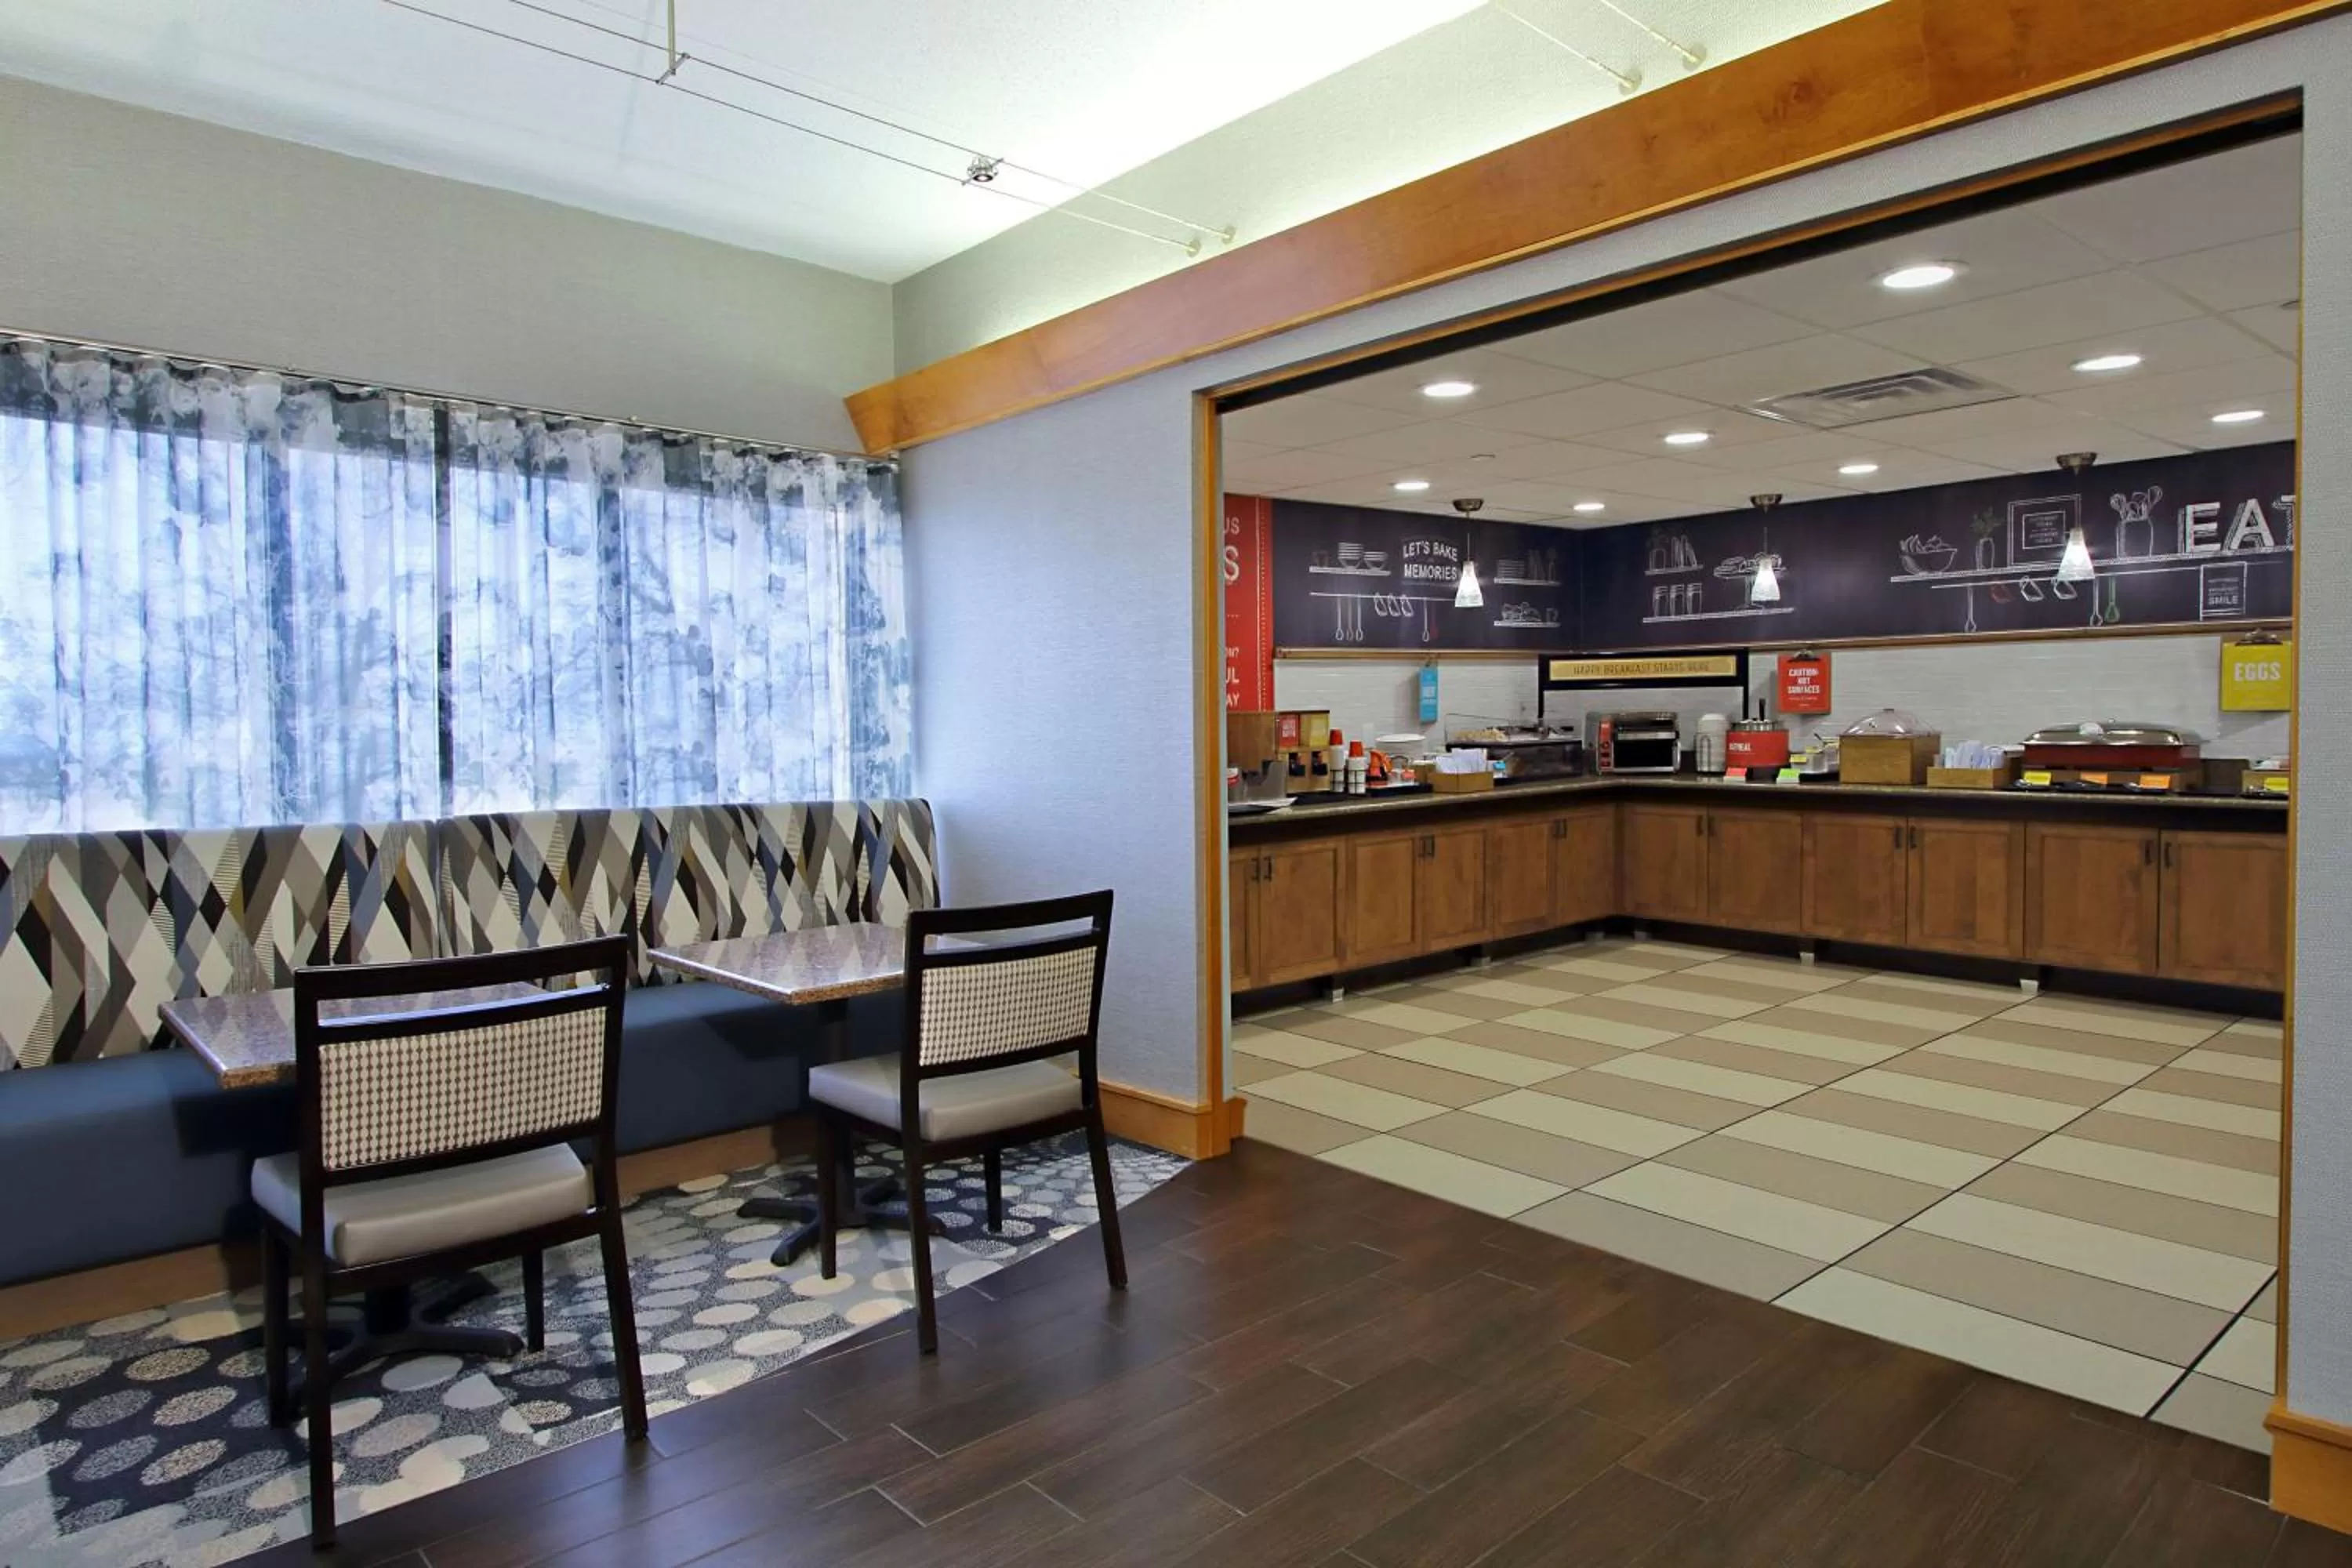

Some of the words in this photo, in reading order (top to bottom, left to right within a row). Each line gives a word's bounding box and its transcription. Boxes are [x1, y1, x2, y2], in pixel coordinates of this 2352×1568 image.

[1403, 541, 1431, 559] LET'S
[1432, 542, 1458, 562] BAKE
[1404, 563, 1458, 580] MEMORIES
[2208, 595, 2239, 606] SMILE
[2234, 662, 2282, 681] EGGS
